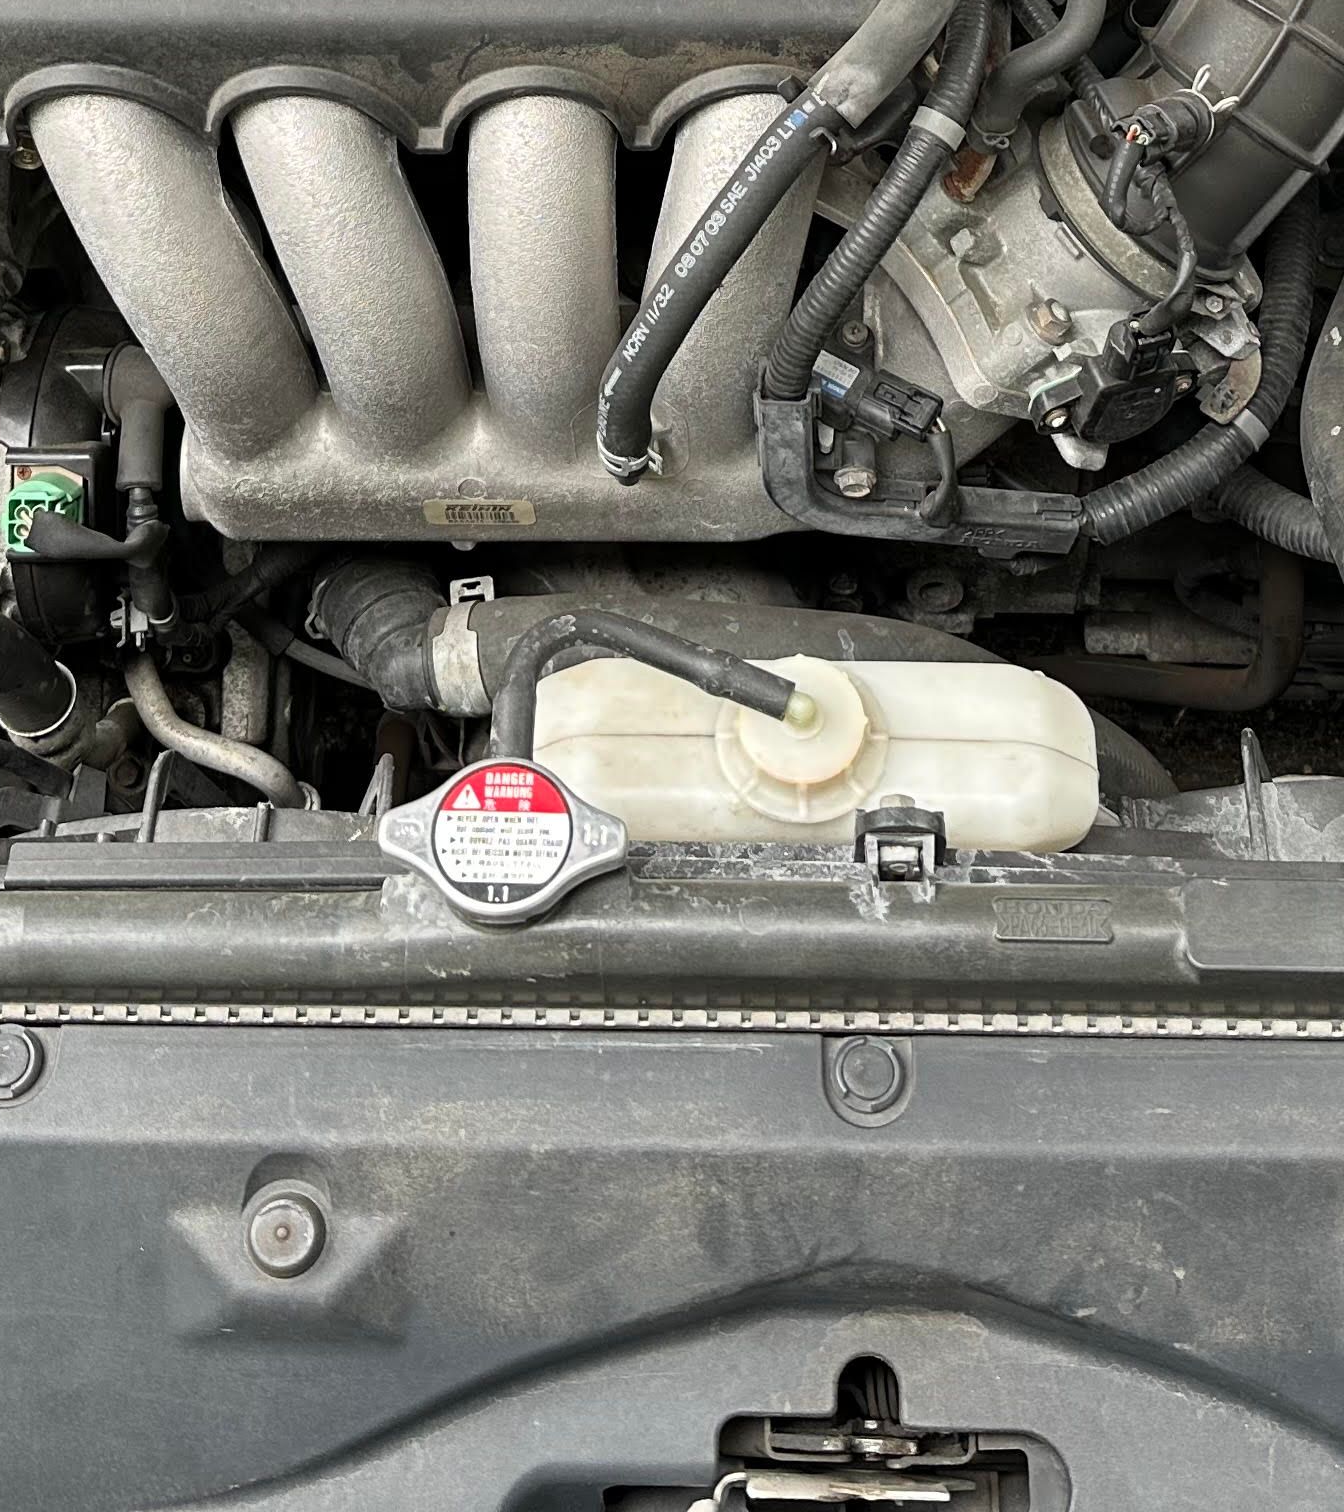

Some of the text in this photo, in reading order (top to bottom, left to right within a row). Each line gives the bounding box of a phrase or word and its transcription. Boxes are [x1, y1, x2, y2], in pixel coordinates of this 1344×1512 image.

[622, 321, 650, 363] NCRN
[719, 180, 748, 215] SAE
[484, 772, 535, 785] DANGER
[484, 786, 534, 799] WARNUNG
[583, 824, 608, 846] 1.1
[487, 884, 510, 903] 1.1
